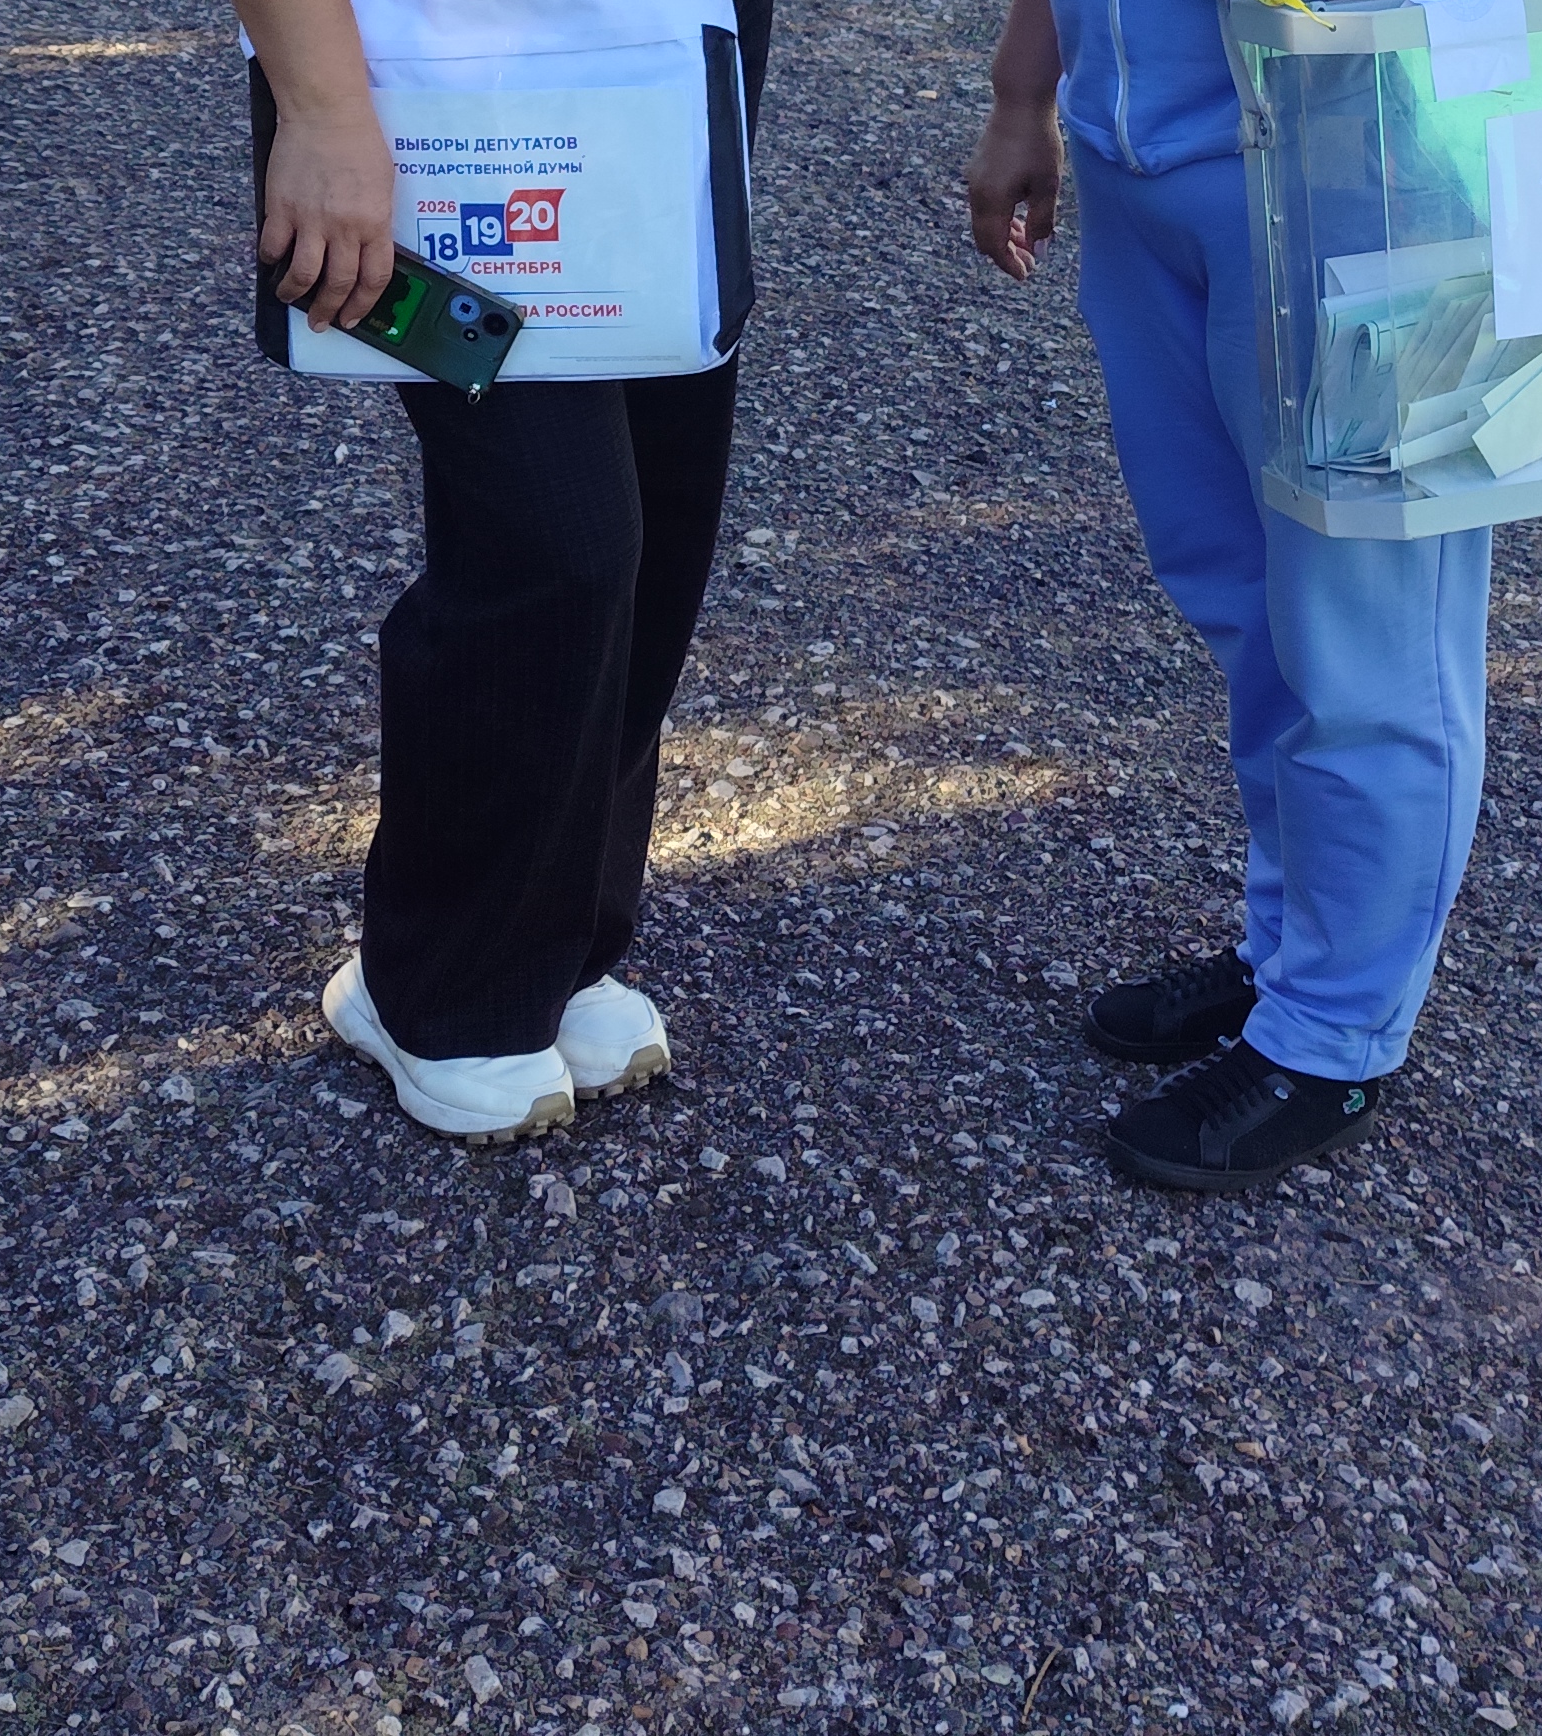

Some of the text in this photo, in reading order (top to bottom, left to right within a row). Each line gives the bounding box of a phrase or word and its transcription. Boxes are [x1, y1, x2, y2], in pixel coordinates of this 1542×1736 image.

[395, 136, 578, 153] ВЫБОРЫ ДЕПУТАТОВ
[537, 162, 583, 175] ДУМЫ
[417, 200, 457, 213] 2026
[508, 200, 555, 231] 20
[465, 215, 503, 246] 19
[423, 232, 459, 262] 18
[471, 262, 562, 274] СЕНТЯБРЯ
[545, 304, 623, 318] РОССИИ!
